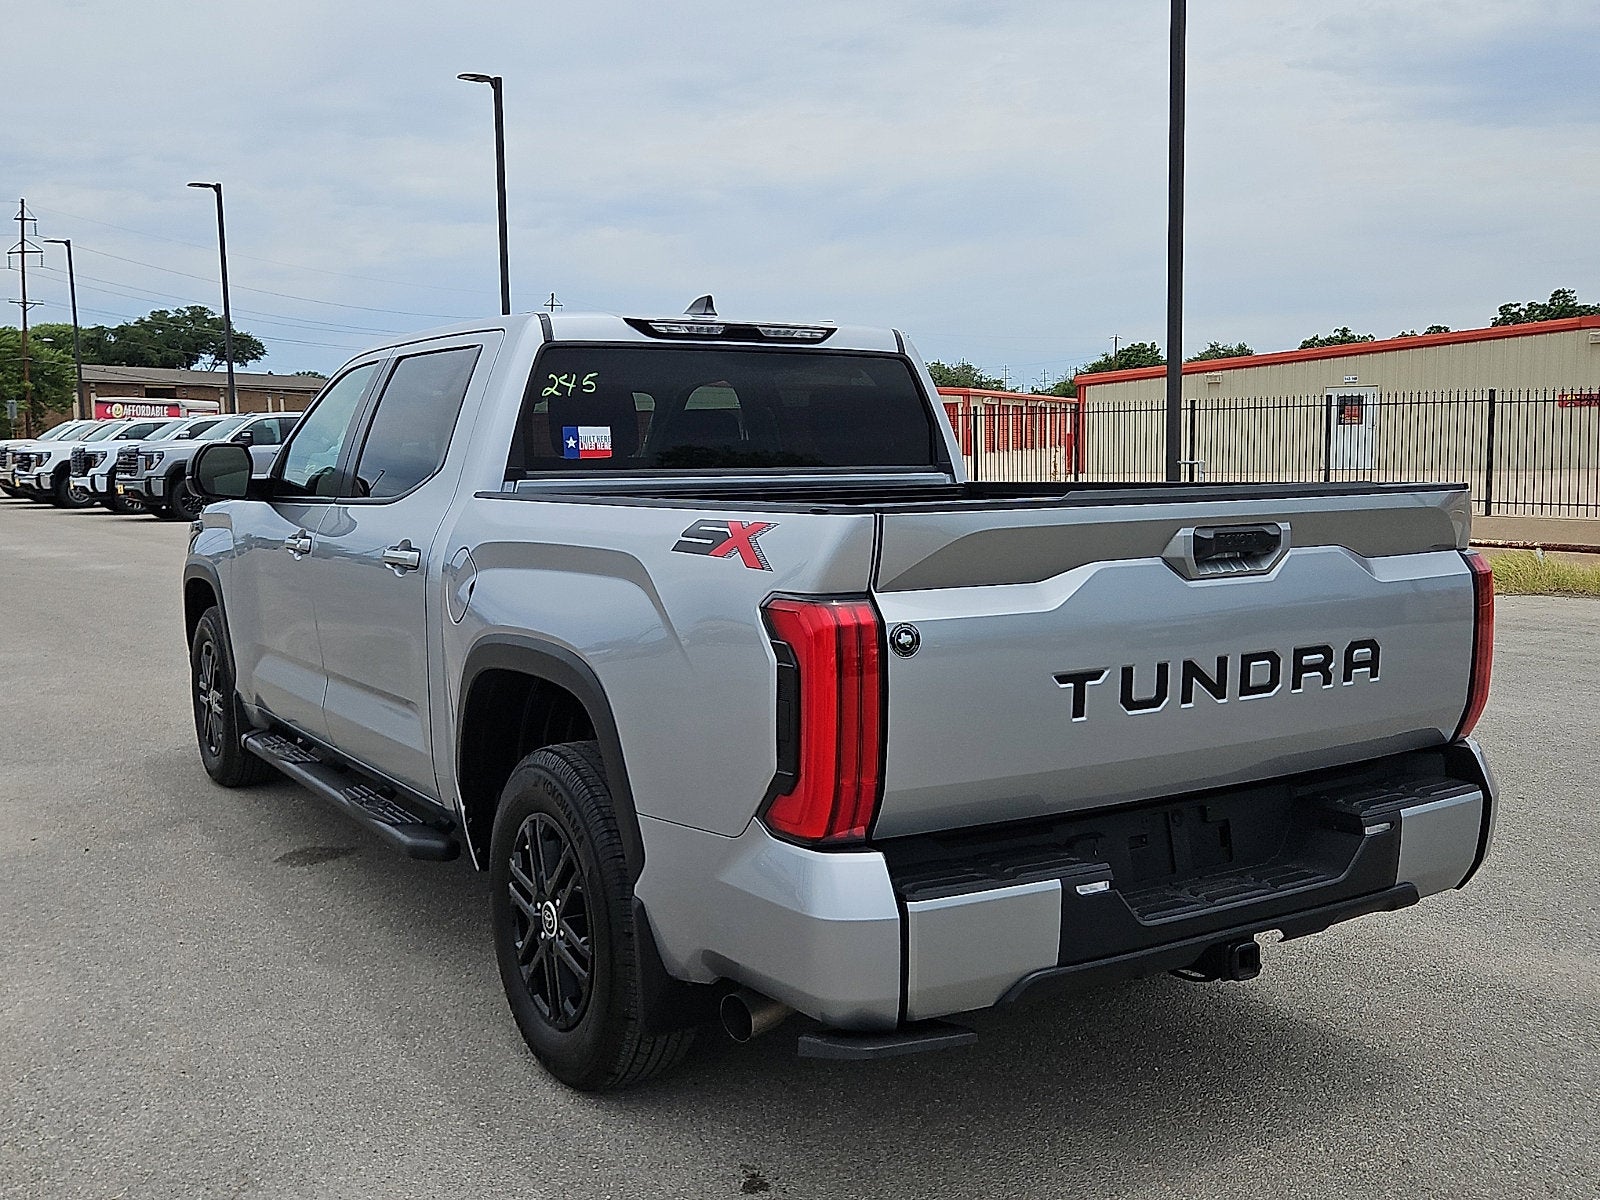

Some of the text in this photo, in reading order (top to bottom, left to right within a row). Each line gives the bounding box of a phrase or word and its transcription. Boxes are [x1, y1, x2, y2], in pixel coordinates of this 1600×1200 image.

[541, 372, 598, 397] 245
[123, 404, 169, 417] AFFORDABLE
[579, 442, 612, 450] LIVES HERE
[671, 519, 780, 572] SX
[1051, 638, 1381, 722] TUNDRA
[542, 777, 585, 849] YOKOHAMA
